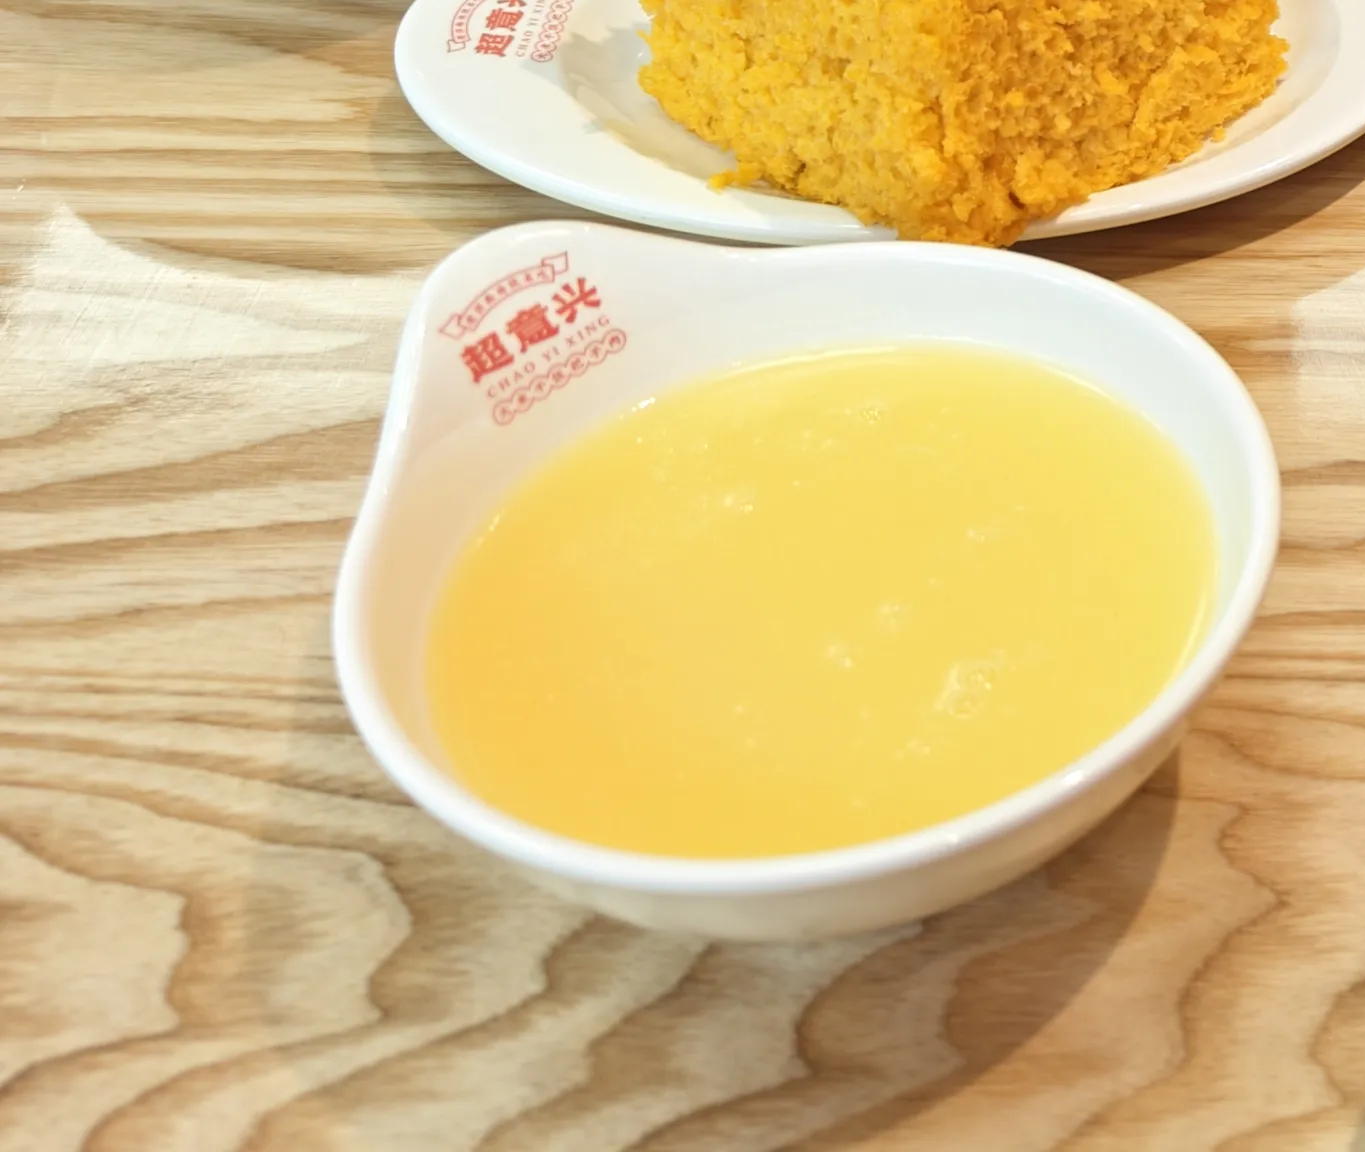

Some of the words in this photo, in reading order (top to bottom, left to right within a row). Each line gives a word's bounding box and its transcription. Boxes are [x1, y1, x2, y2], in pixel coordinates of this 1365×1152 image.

[461, 277, 601, 383] 超意兴
[487, 361, 536, 399] CHAO
[542, 347, 560, 362] YI
[566, 315, 611, 349] XING
